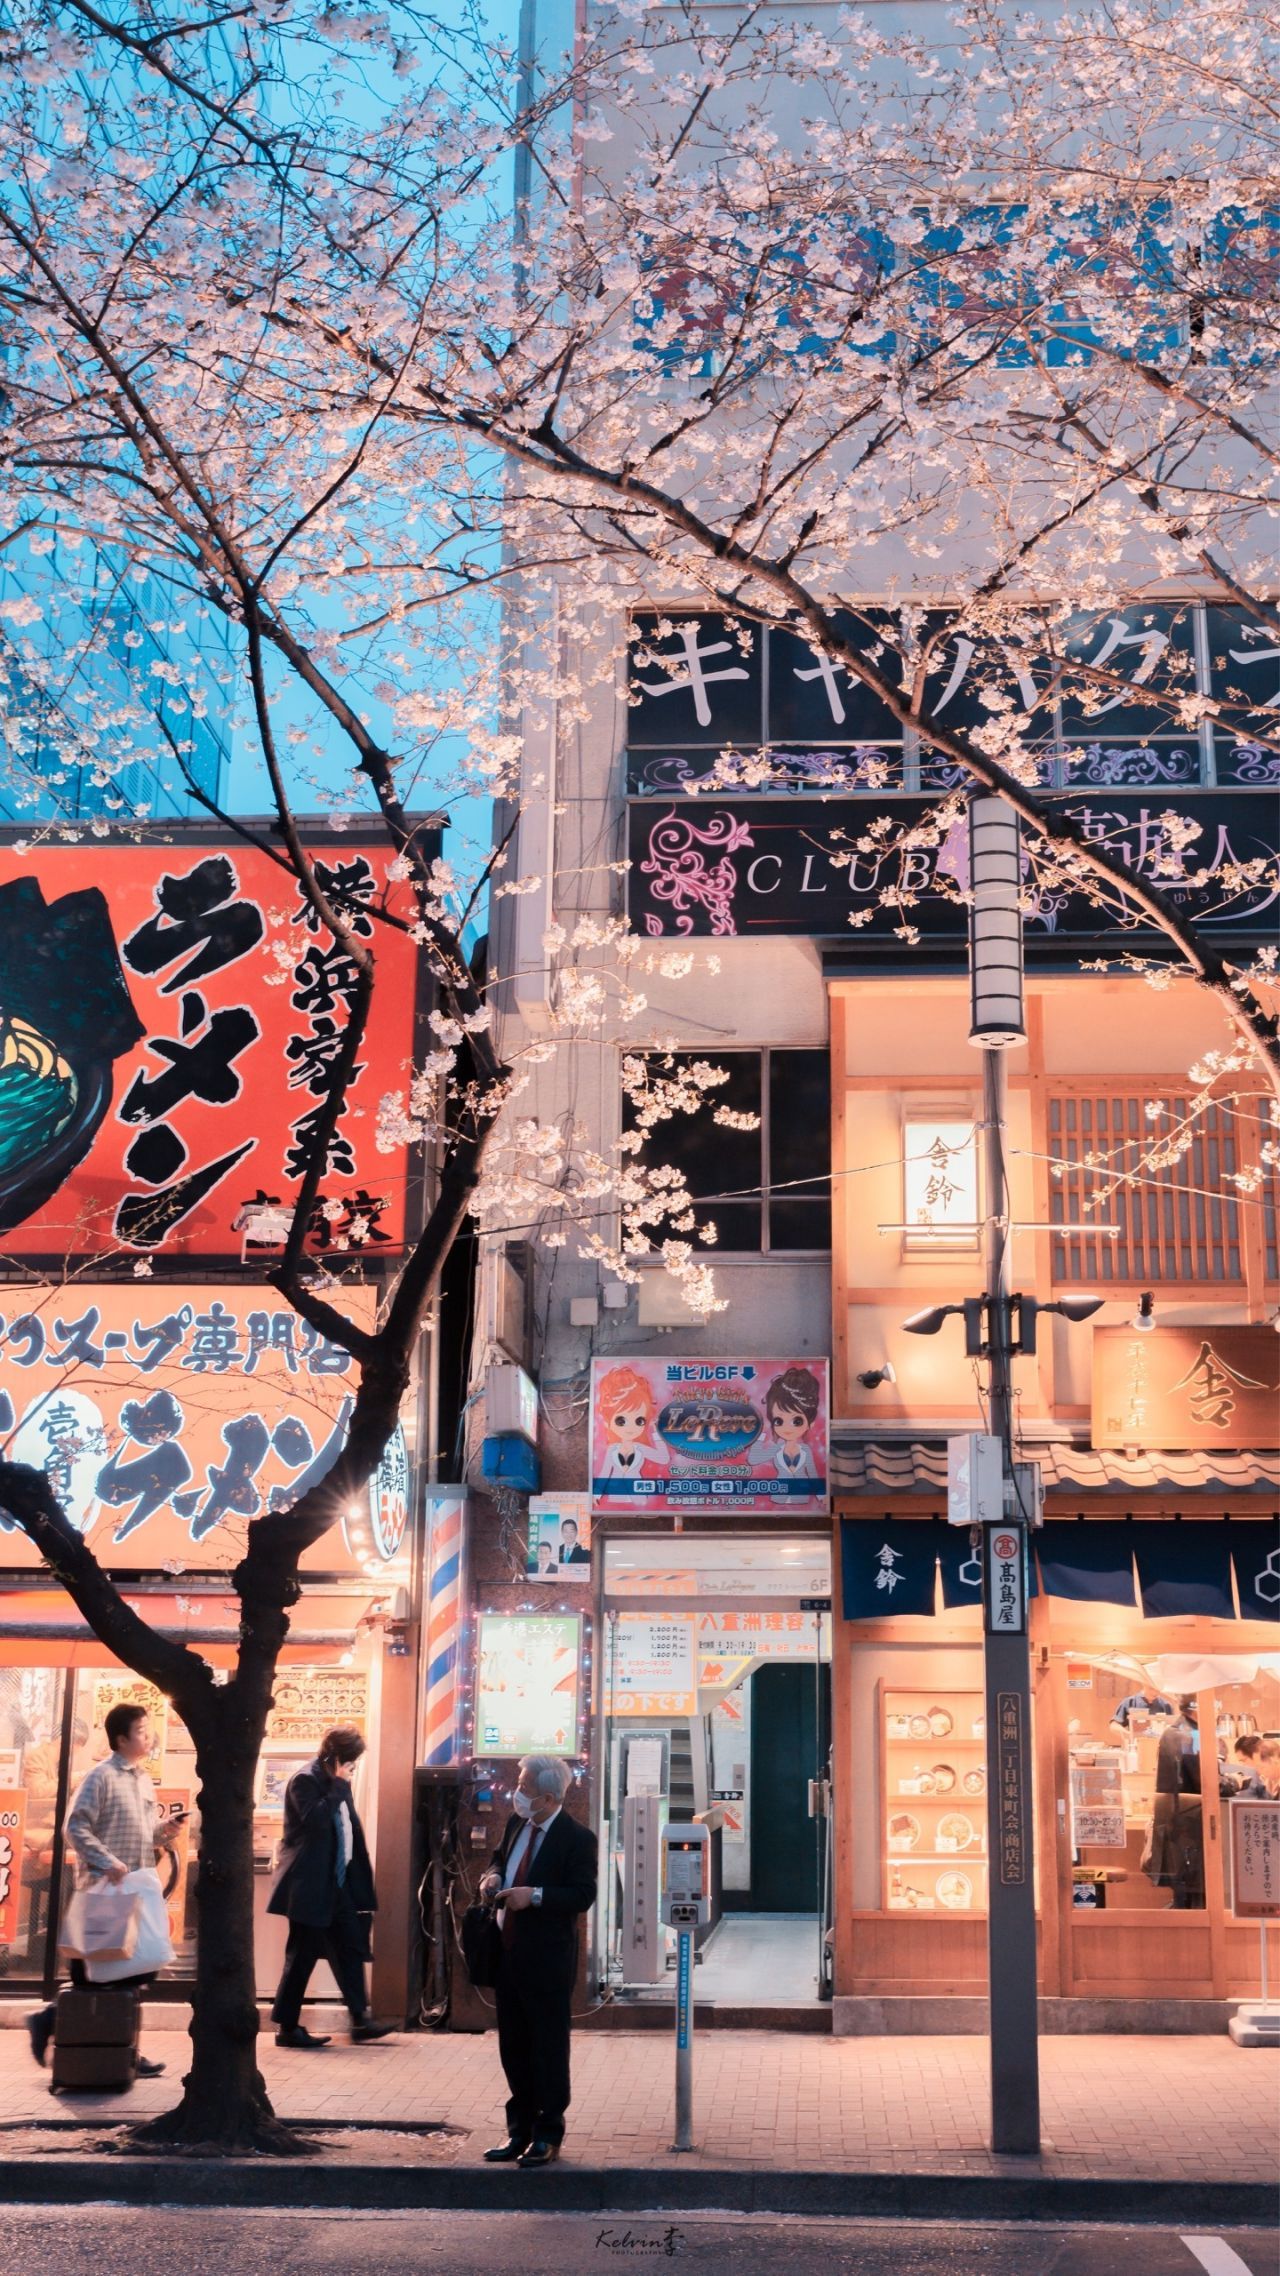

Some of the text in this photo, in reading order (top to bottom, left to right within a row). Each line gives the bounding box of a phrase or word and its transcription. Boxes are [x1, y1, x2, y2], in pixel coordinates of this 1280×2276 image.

[746, 854, 936, 895] CLUB
[112, 852, 267, 1250] ラーメン
[0, 1301, 354, 1377] つスープ専門店
[667, 1366, 739, 1381] 当ビル6F
[1166, 1341, 1280, 1430] 舎
[96, 1388, 357, 1544] ラーメン
[657, 1481, 710, 1493] 1,500円
[714, 1482, 732, 1491] 女性
[735, 1481, 789, 1493] 1,000円
[809, 1579, 828, 1592] 6F
[700, 1612, 804, 1631] 八重洲理容
